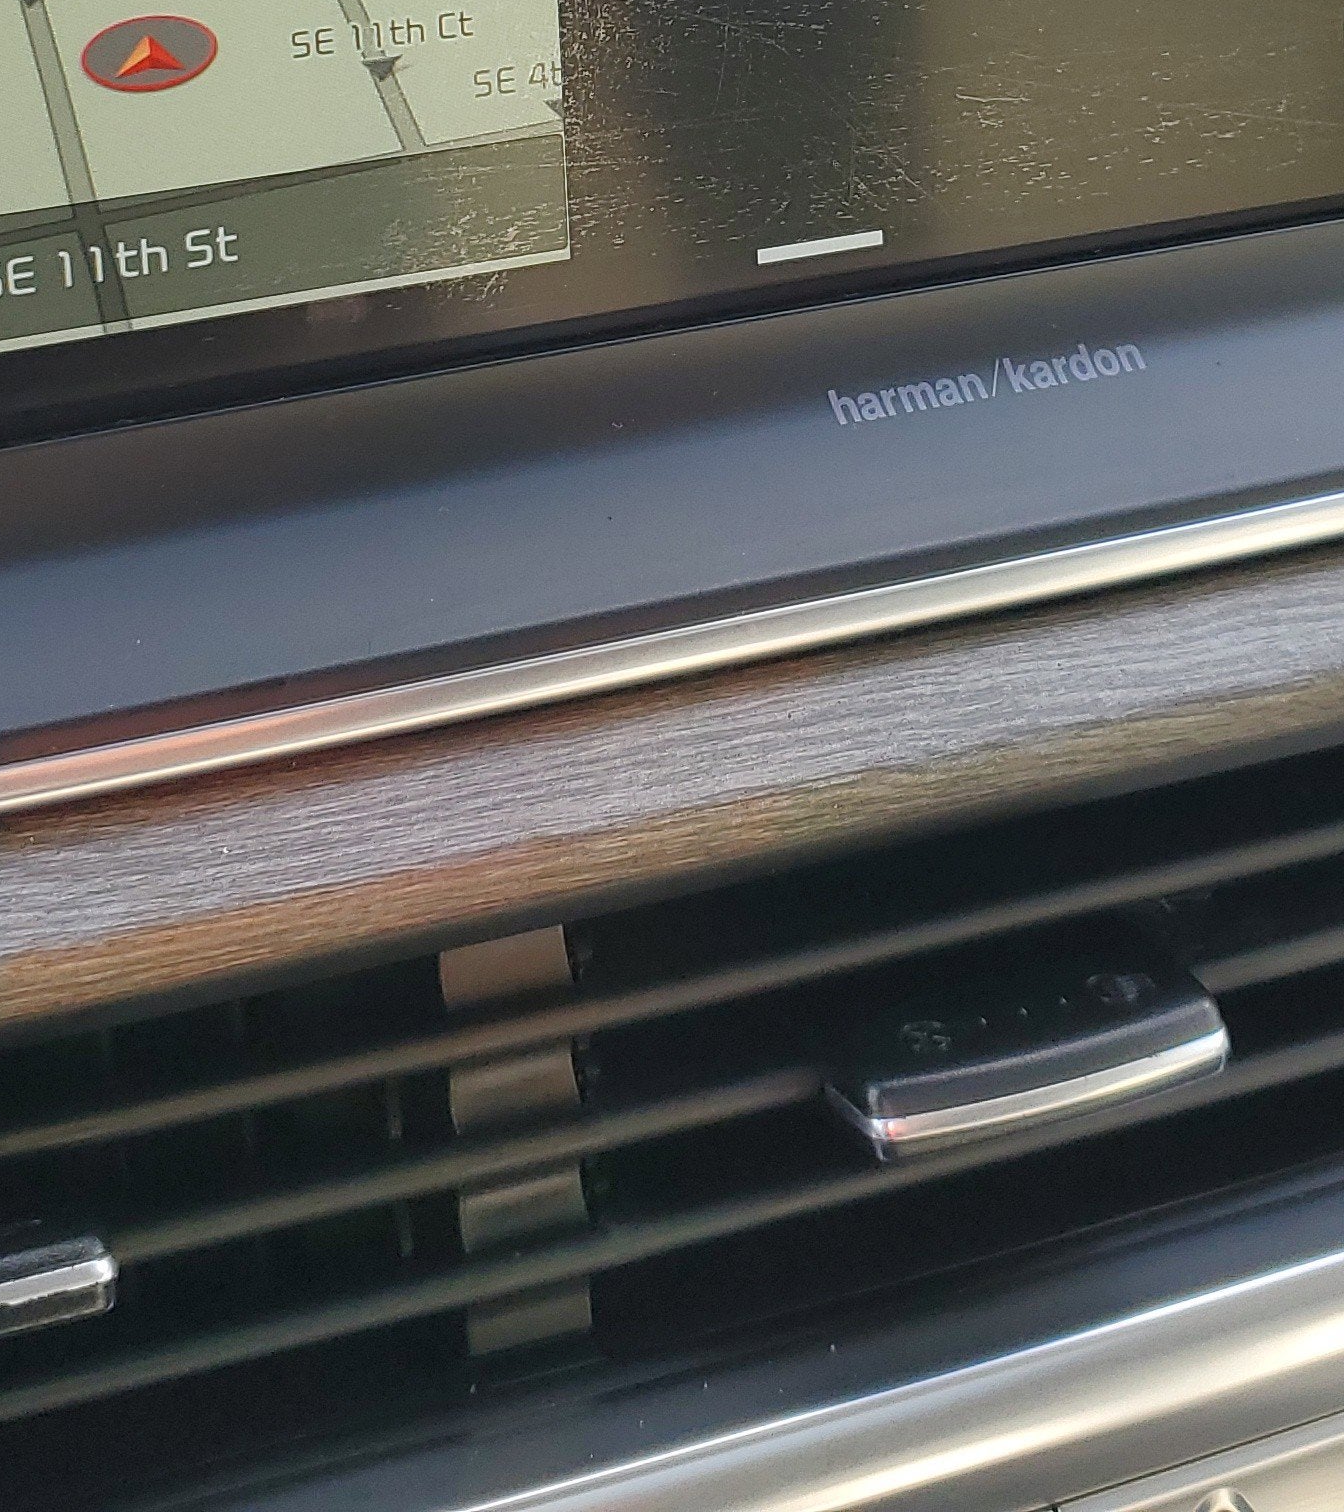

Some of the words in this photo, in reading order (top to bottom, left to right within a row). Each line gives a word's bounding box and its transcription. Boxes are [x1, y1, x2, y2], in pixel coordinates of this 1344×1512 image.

[291, 28, 335, 58] SE
[351, 18, 425, 50] 11th
[438, 10, 475, 39] Ct
[473, 67, 516, 98] SE
[59, 240, 169, 289] 11th
[184, 226, 239, 269] St
[827, 343, 1148, 426] harman/kardon
